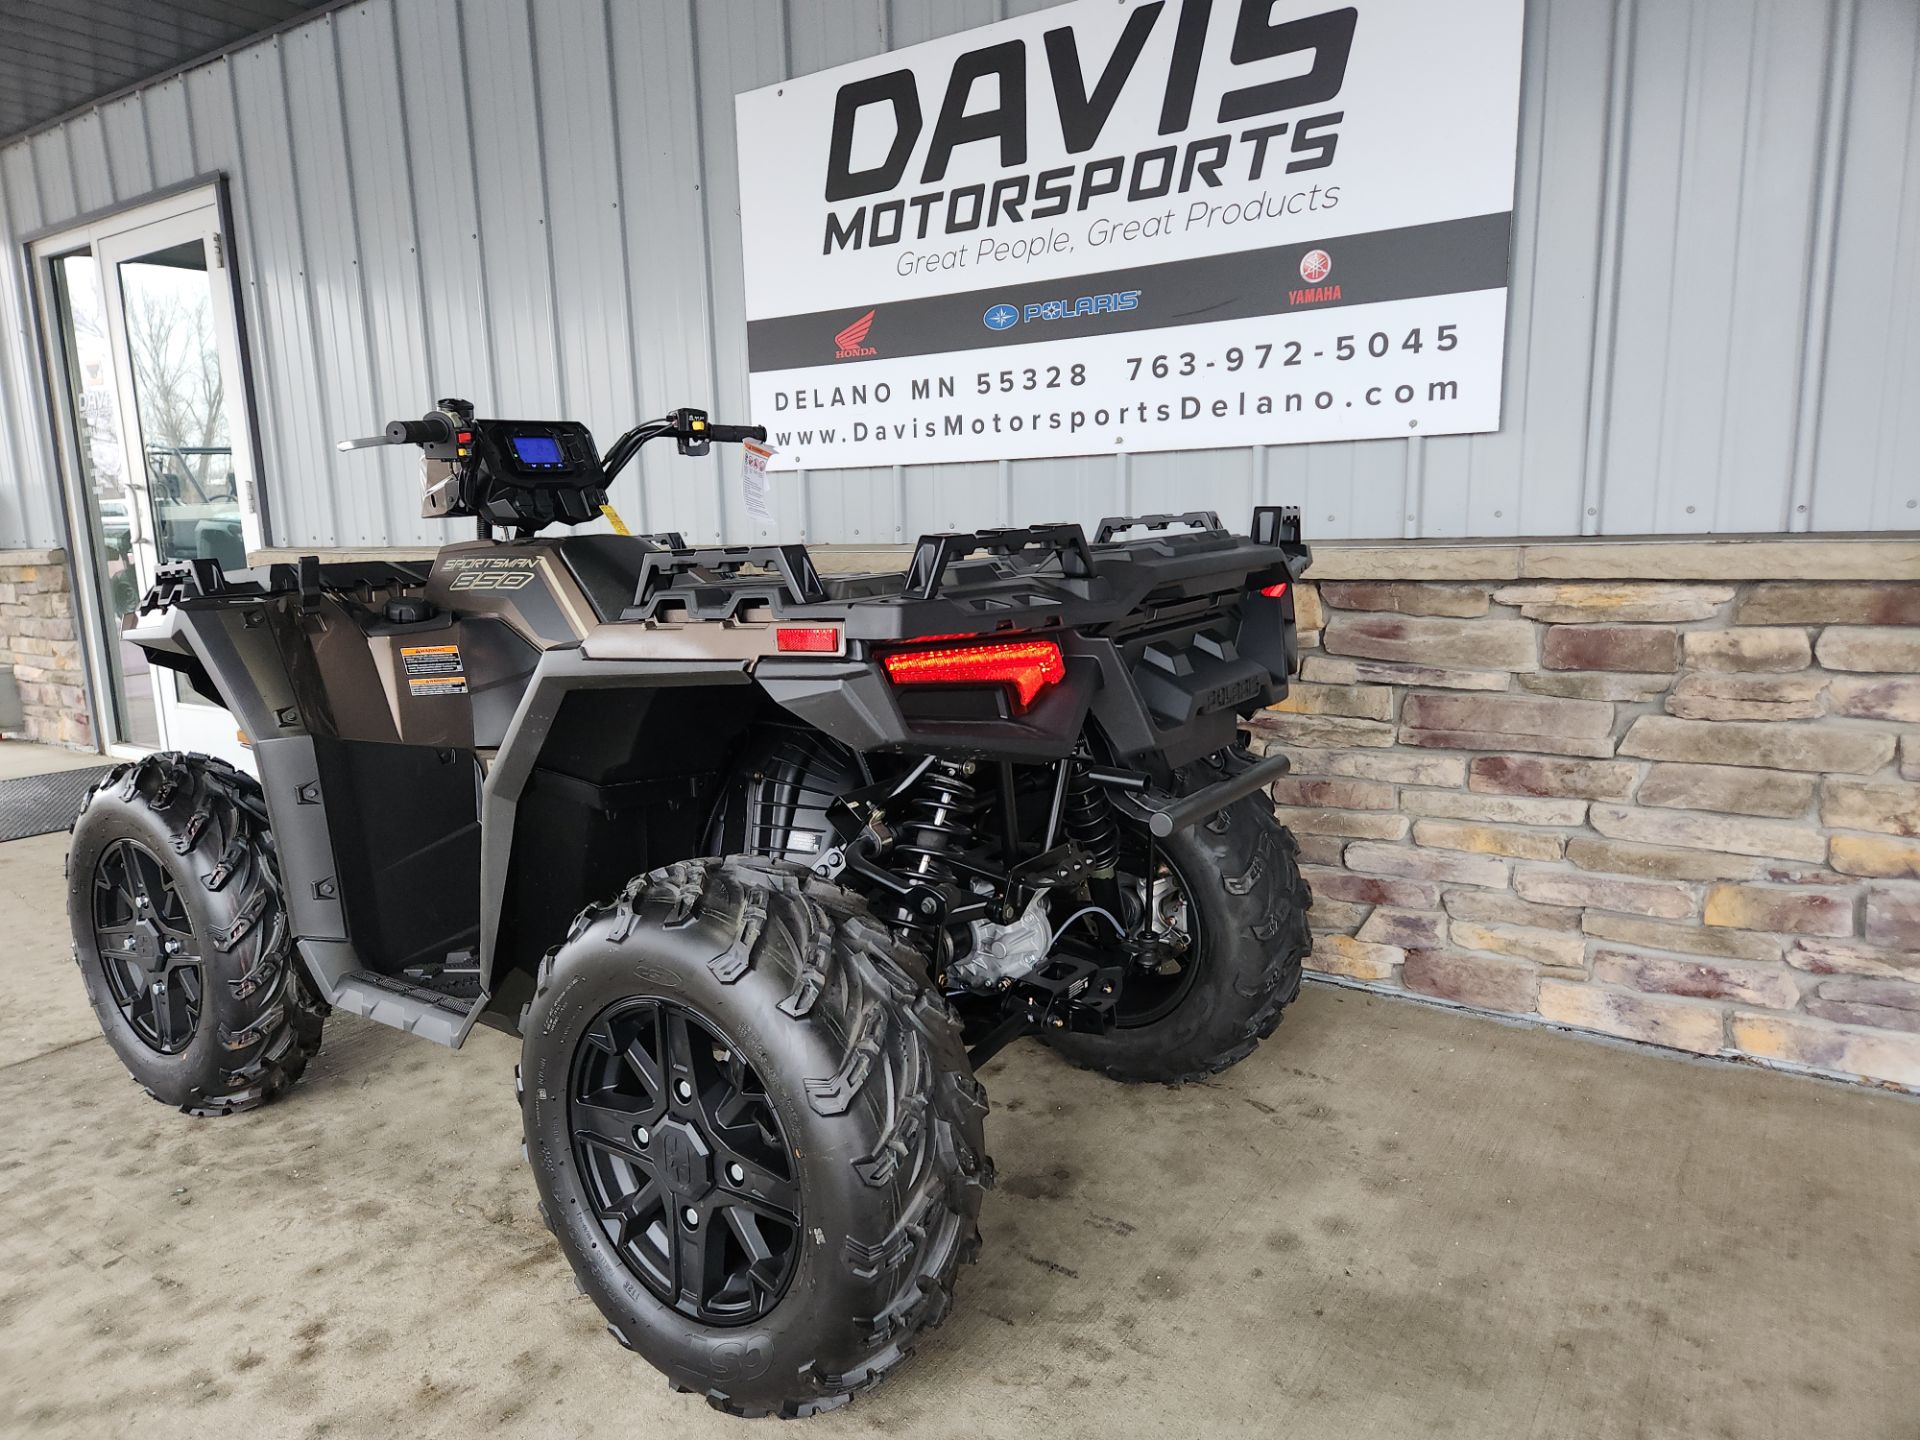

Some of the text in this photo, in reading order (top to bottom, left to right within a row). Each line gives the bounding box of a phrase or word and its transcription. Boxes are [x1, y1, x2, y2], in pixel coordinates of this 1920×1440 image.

[825, 0, 1358, 202] DAVIS
[823, 111, 1344, 255] MOTORSPORTS
[897, 184, 1341, 277] Great People, Great Products
[1023, 290, 1139, 323] POLARIS
[1288, 285, 1342, 305] YAMAHA
[775, 324, 1458, 411] DELANO MN 55328 763-972-5045
[835, 347, 878, 360] HONDA
[776, 379, 1458, 447] www.DavisMotorsportsDelano.com
[441, 558, 540, 571] SPORTSMAN
[449, 571, 535, 591] 850
